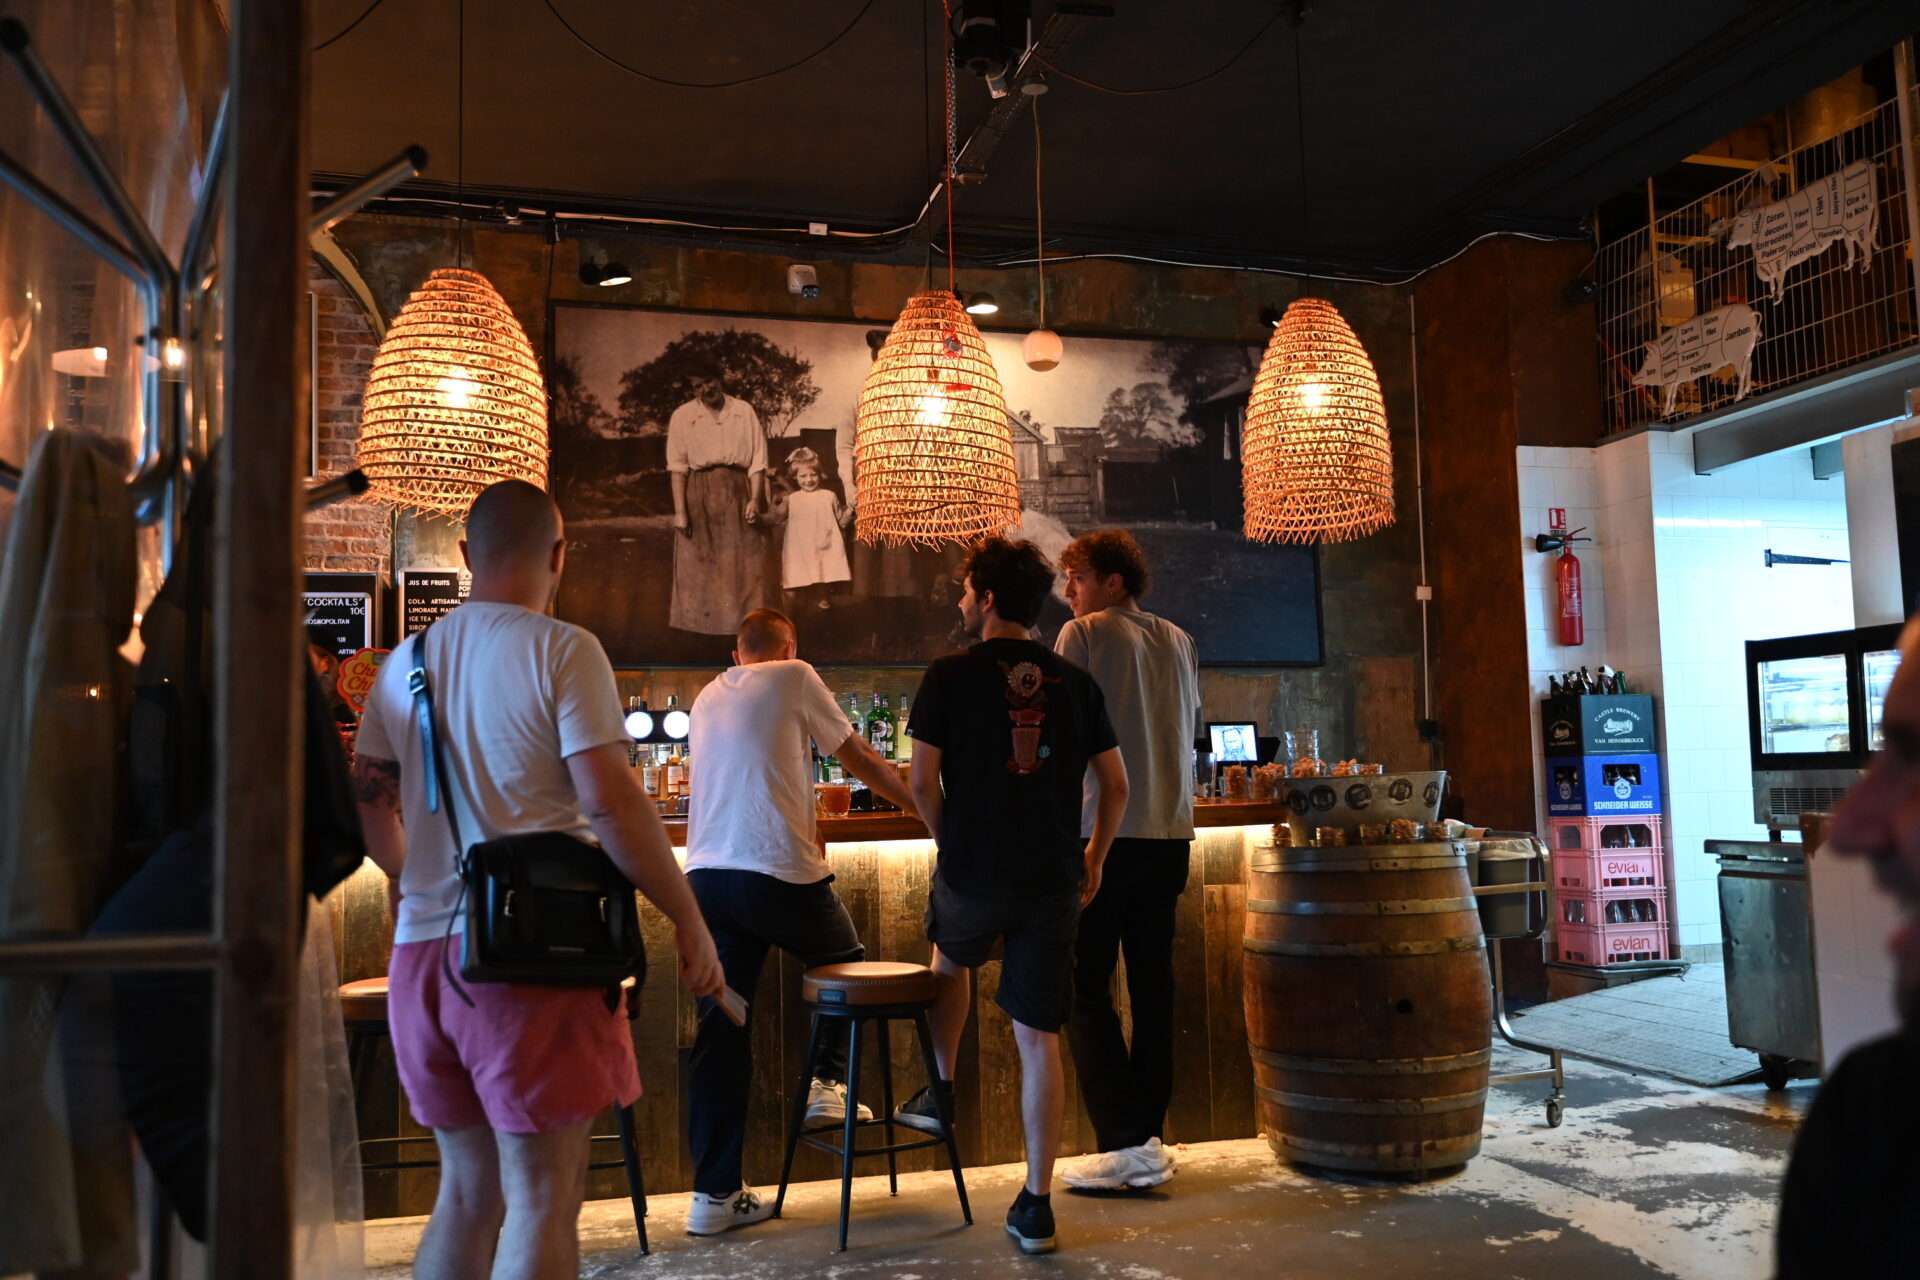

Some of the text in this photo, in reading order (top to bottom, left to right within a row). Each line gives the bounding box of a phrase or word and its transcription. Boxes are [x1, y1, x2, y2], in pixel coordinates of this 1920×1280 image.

[350, 607, 365, 615] 10€
[1593, 801, 1628, 810] SCHNEIDER
[1629, 800, 1653, 809] WEISSE
[1613, 936, 1651, 951] evian
